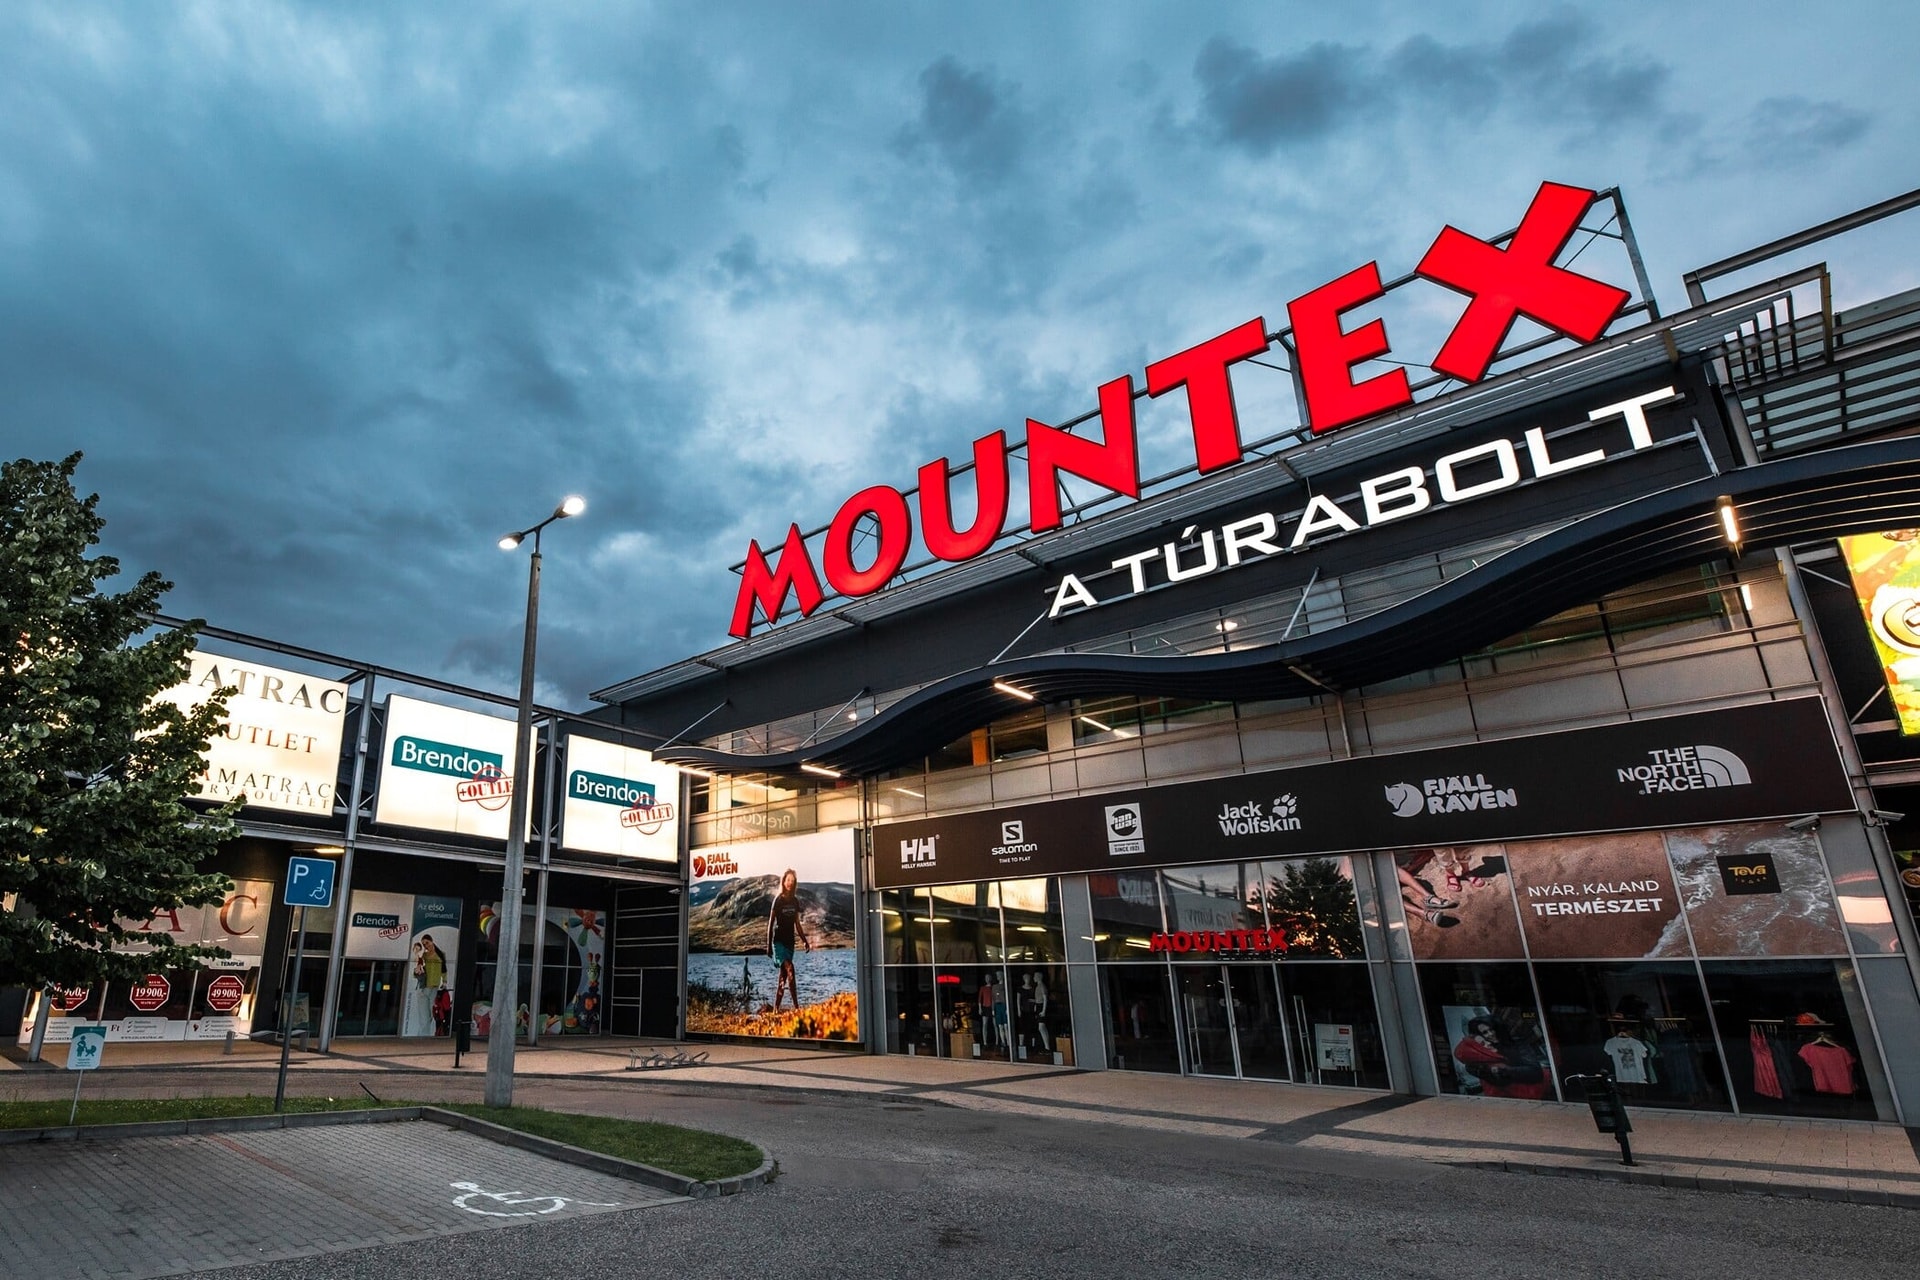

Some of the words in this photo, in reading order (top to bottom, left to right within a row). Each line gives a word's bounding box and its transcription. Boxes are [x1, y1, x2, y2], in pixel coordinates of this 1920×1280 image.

[728, 180, 1632, 640] MOUNTEX
[1048, 574, 1098, 619] A
[1111, 385, 1677, 594] TÚRABOLT
[225, 722, 318, 753] UTLET
[400, 740, 497, 777] Brendon
[1648, 746, 1696, 764] THE
[1617, 760, 1702, 783] NORTH
[458, 780, 513, 799] +OUTLE
[575, 774, 652, 805] Brendon
[1644, 774, 1705, 794] FACE
[1218, 801, 1262, 821] Jack
[1218, 815, 1302, 837] Wolfskin
[293, 864, 309, 884] P
[901, 862, 916, 870] HELLY
[916, 861, 937, 869] HANSEN
[1583, 880, 1660, 895] KALAND
[1531, 897, 1663, 916] TERMÉSZET
[356, 914, 396, 926] Brendon
[1149, 927, 1289, 954] MOUNTEX
